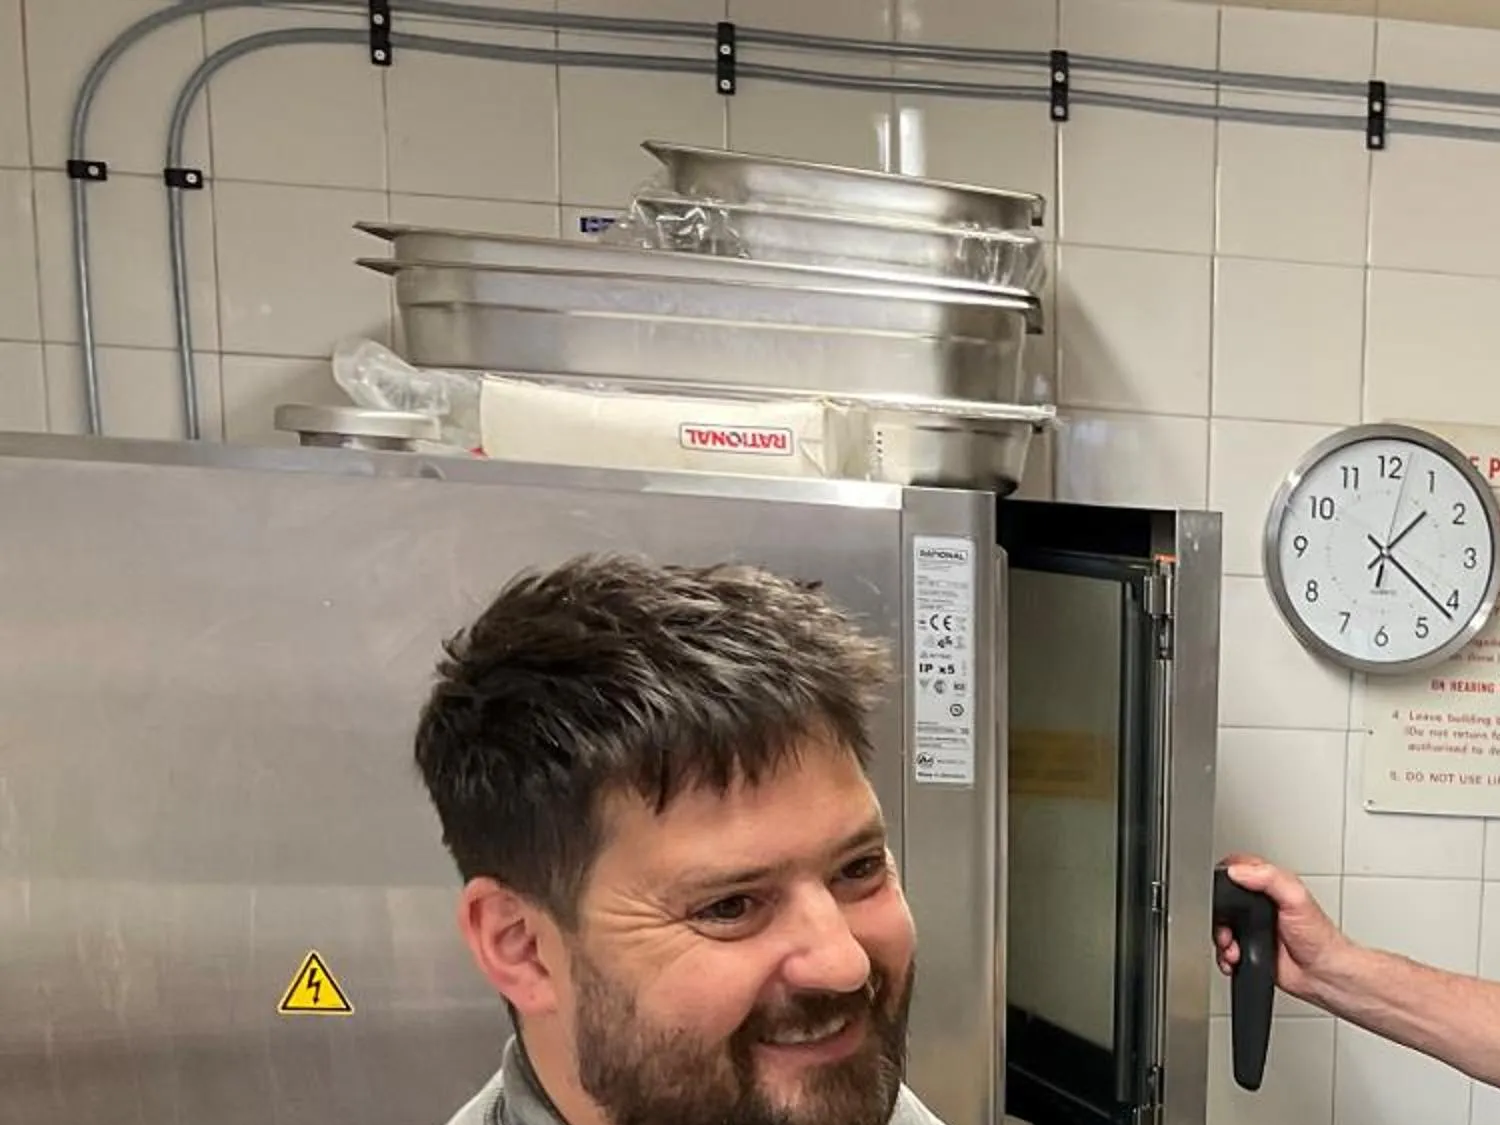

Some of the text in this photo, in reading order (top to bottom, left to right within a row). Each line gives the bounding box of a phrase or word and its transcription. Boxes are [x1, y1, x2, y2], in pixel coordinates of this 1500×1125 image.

[685, 428, 787, 449] RATIONAL
[1340, 466, 1360, 490] 11
[1377, 455, 1404, 480] 12
[1427, 470, 1436, 494] 1
[1309, 495, 1336, 520] 10
[1451, 502, 1467, 526] 2
[1292, 534, 1309, 559] 9
[1462, 546, 1478, 570] 3
[1304, 578, 1319, 603] 8
[1445, 588, 1460, 612] 4
[1338, 610, 1352, 634] 7
[1414, 616, 1430, 639] 5
[1373, 624, 1390, 648] 6
[1431, 680, 1445, 691] ON
[1450, 680, 1495, 693] HEARING
[1409, 711, 1442, 722] Leave
[1447, 713, 1491, 727] building
[1429, 728, 1448, 738] not
[1452, 730, 1487, 740] return
[1405, 771, 1424, 782] DO
[1429, 773, 1455, 783] NOT
[1459, 774, 1483, 785] USE
